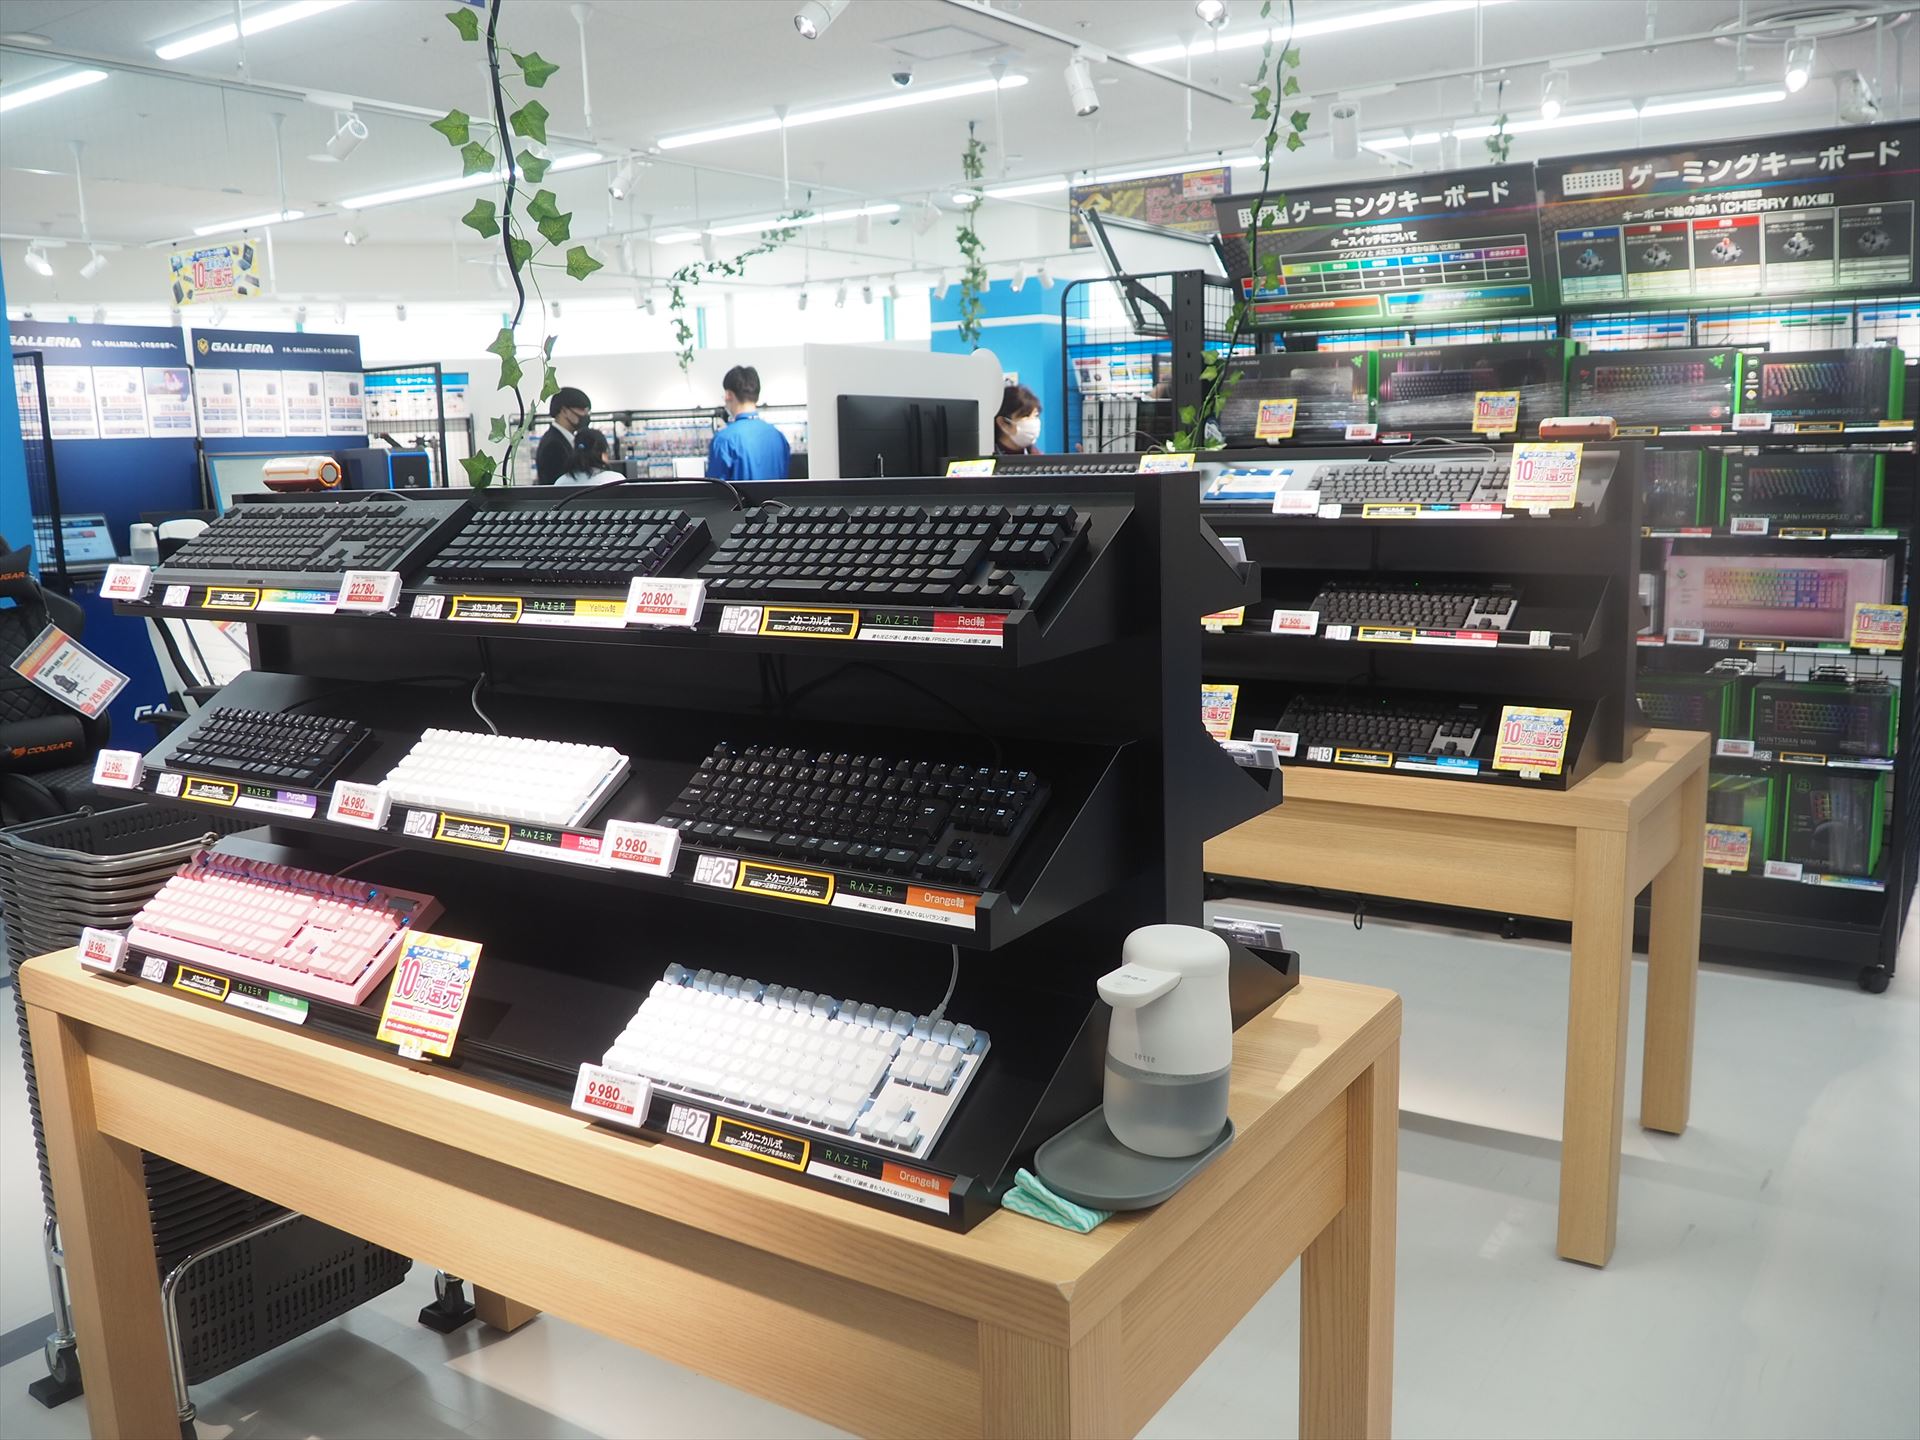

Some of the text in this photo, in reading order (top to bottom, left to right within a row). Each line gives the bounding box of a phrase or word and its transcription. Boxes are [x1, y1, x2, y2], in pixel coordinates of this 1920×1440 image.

[1628, 140, 1901, 188] ゲーミングキーボード
[1291, 181, 1509, 222] ゲーミングキーボード
[1331, 231, 1418, 248] キースイッチについて
[211, 342, 275, 354] GALLERIA
[534, 601, 566, 610] RAZER
[738, 609, 760, 632] 22
[788, 615, 832, 626] メカニカル式
[875, 614, 919, 625] RAZER
[958, 615, 986, 627] Red軸
[1503, 721, 1563, 748] 10%還元
[27, 741, 74, 756] COUGAR
[1318, 748, 1332, 762] 13
[247, 786, 272, 797] RAZER
[418, 814, 435, 835] 24
[520, 828, 553, 842] RAZER
[712, 860, 736, 885] 25
[765, 873, 808, 888] メカニカル式
[1808, 875, 1820, 884] 18
[849, 880, 893, 896] RAZER
[924, 892, 965, 908] Orange軸
[152, 960, 166, 979] 26
[238, 983, 262, 996] RAZER
[396, 957, 465, 1010] 10%還元
[686, 1111, 709, 1138] 27
[739, 1129, 784, 1151] メカニカル式
[825, 1149, 869, 1170] RAZER
[900, 1170, 940, 1190] Orange軸
